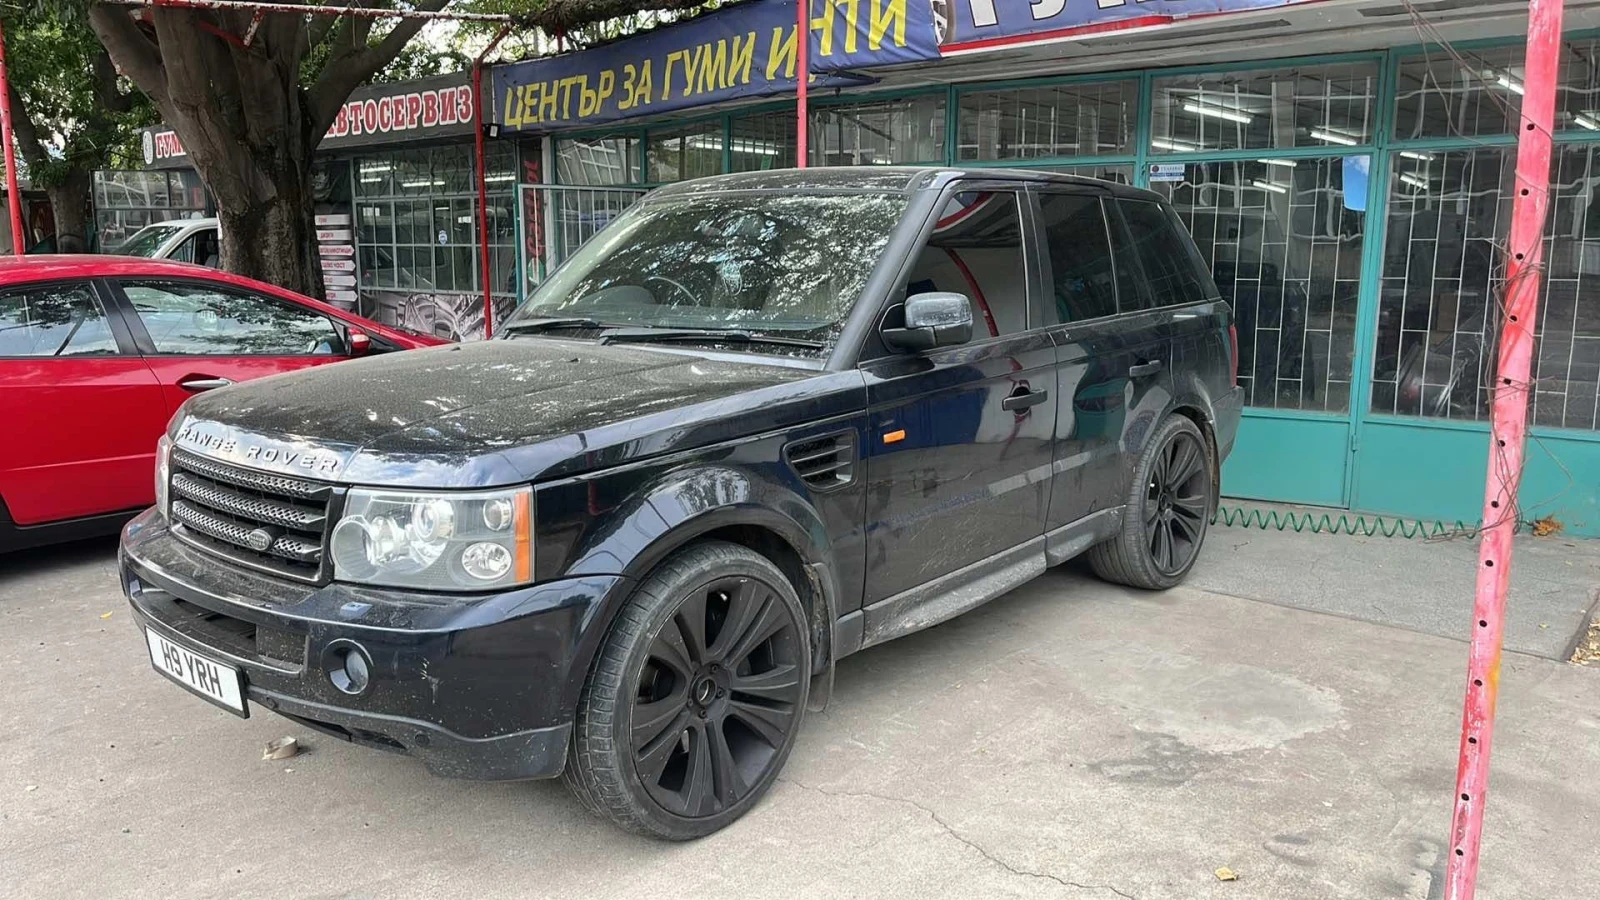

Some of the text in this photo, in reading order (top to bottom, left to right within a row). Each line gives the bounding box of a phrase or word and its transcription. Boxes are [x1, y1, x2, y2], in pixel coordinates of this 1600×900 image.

[504, 69, 616, 131] ЦЕНТЪР
[618, 59, 652, 110] ЗА
[661, 31, 757, 100] ГУМИ
[766, 25, 798, 80] И
[810, 0, 907, 56] НТИ
[154, 130, 187, 159] ГУМ
[178, 427, 338, 473] RANGE ROVER
[160, 638, 224, 698] H9 YRH
